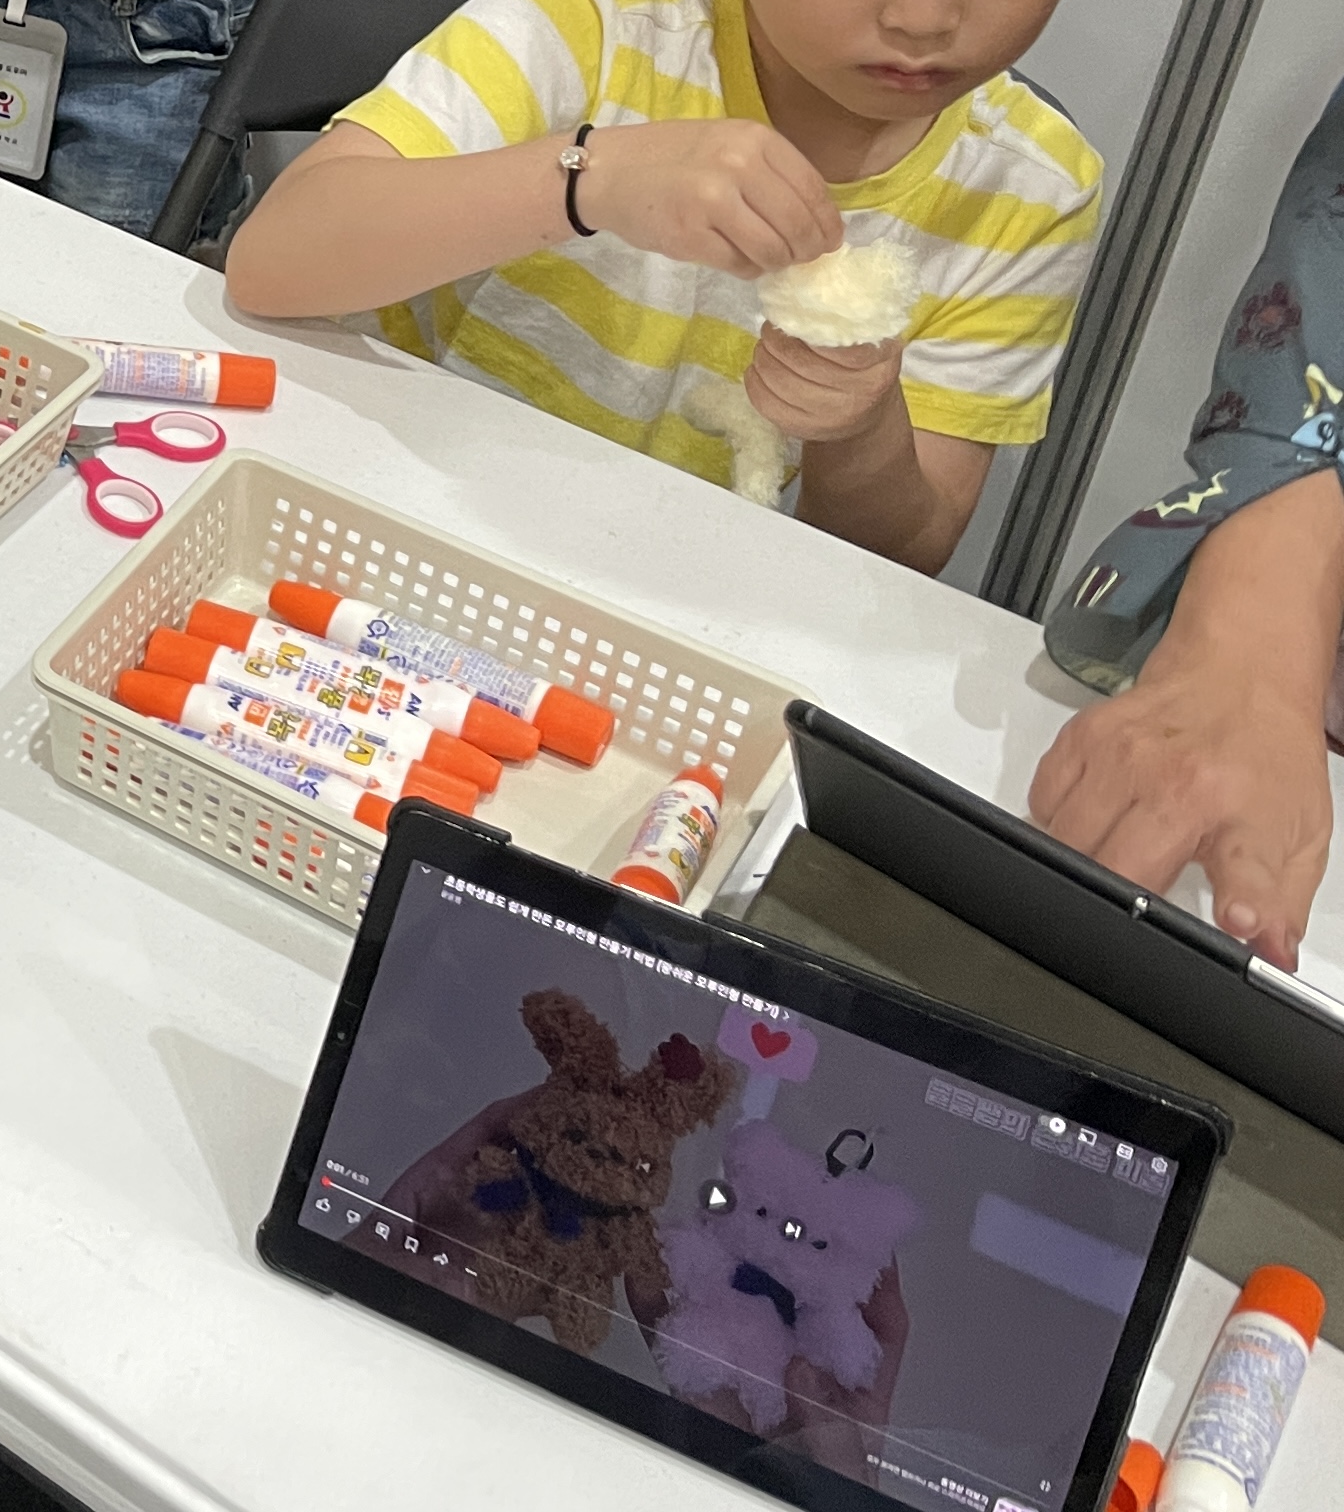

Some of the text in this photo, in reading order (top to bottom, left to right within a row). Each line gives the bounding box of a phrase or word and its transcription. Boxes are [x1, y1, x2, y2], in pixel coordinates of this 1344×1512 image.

[554, 919, 597, 945] 모루인형
[599, 936, 632, 959] 만들기
[695, 974, 739, 1001] 모루인형
